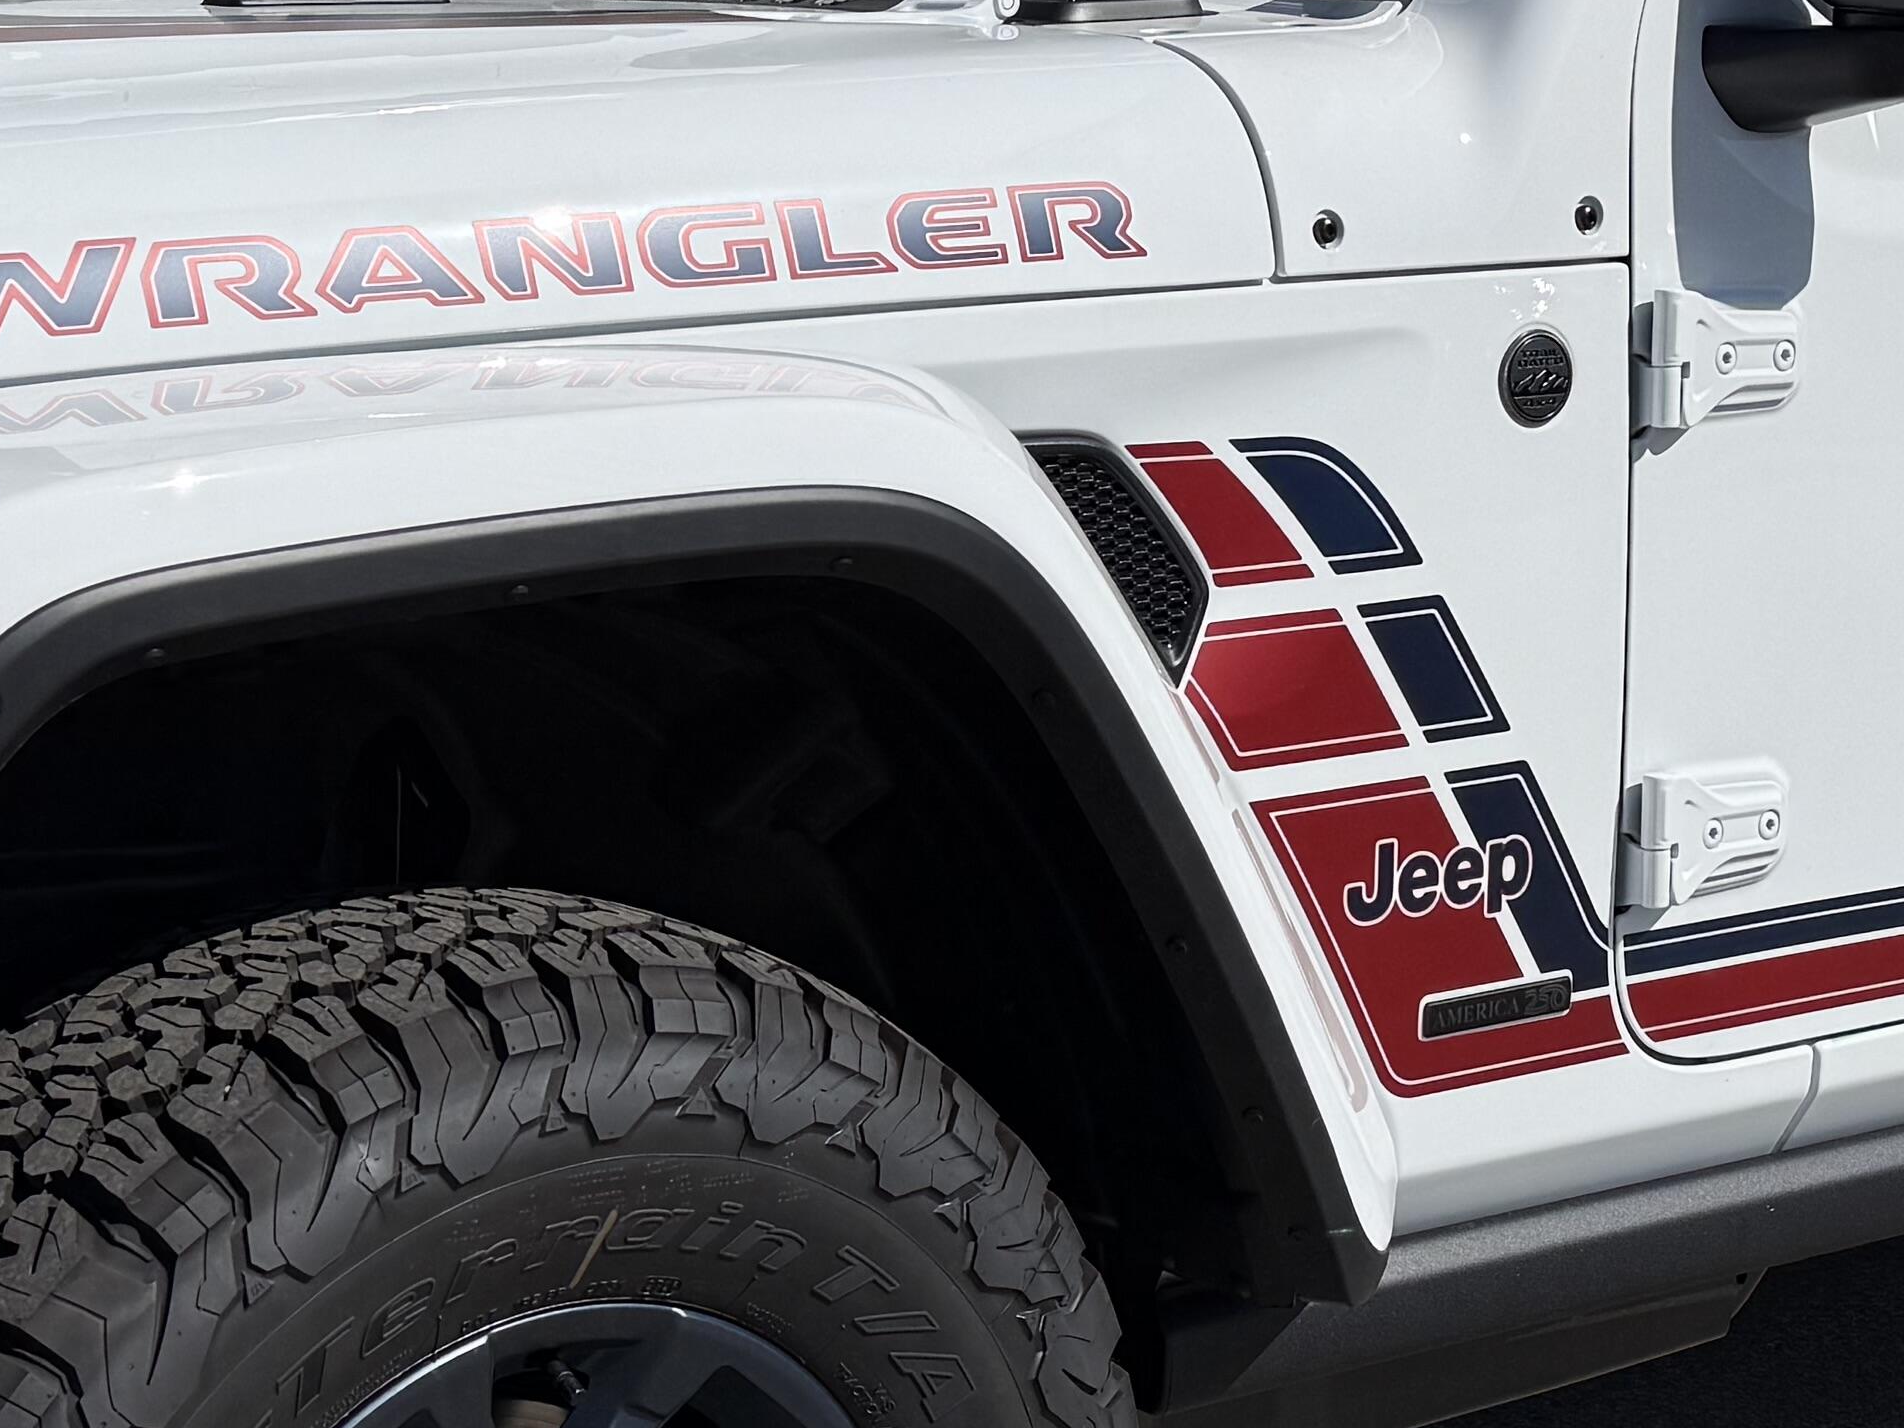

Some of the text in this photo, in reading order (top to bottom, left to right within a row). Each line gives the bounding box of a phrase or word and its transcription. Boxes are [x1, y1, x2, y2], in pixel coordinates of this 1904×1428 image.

[1516, 356, 1564, 368] RATED
[1344, 834, 1533, 927] Jeep
[1432, 983, 1570, 1030] AMERICA 250
